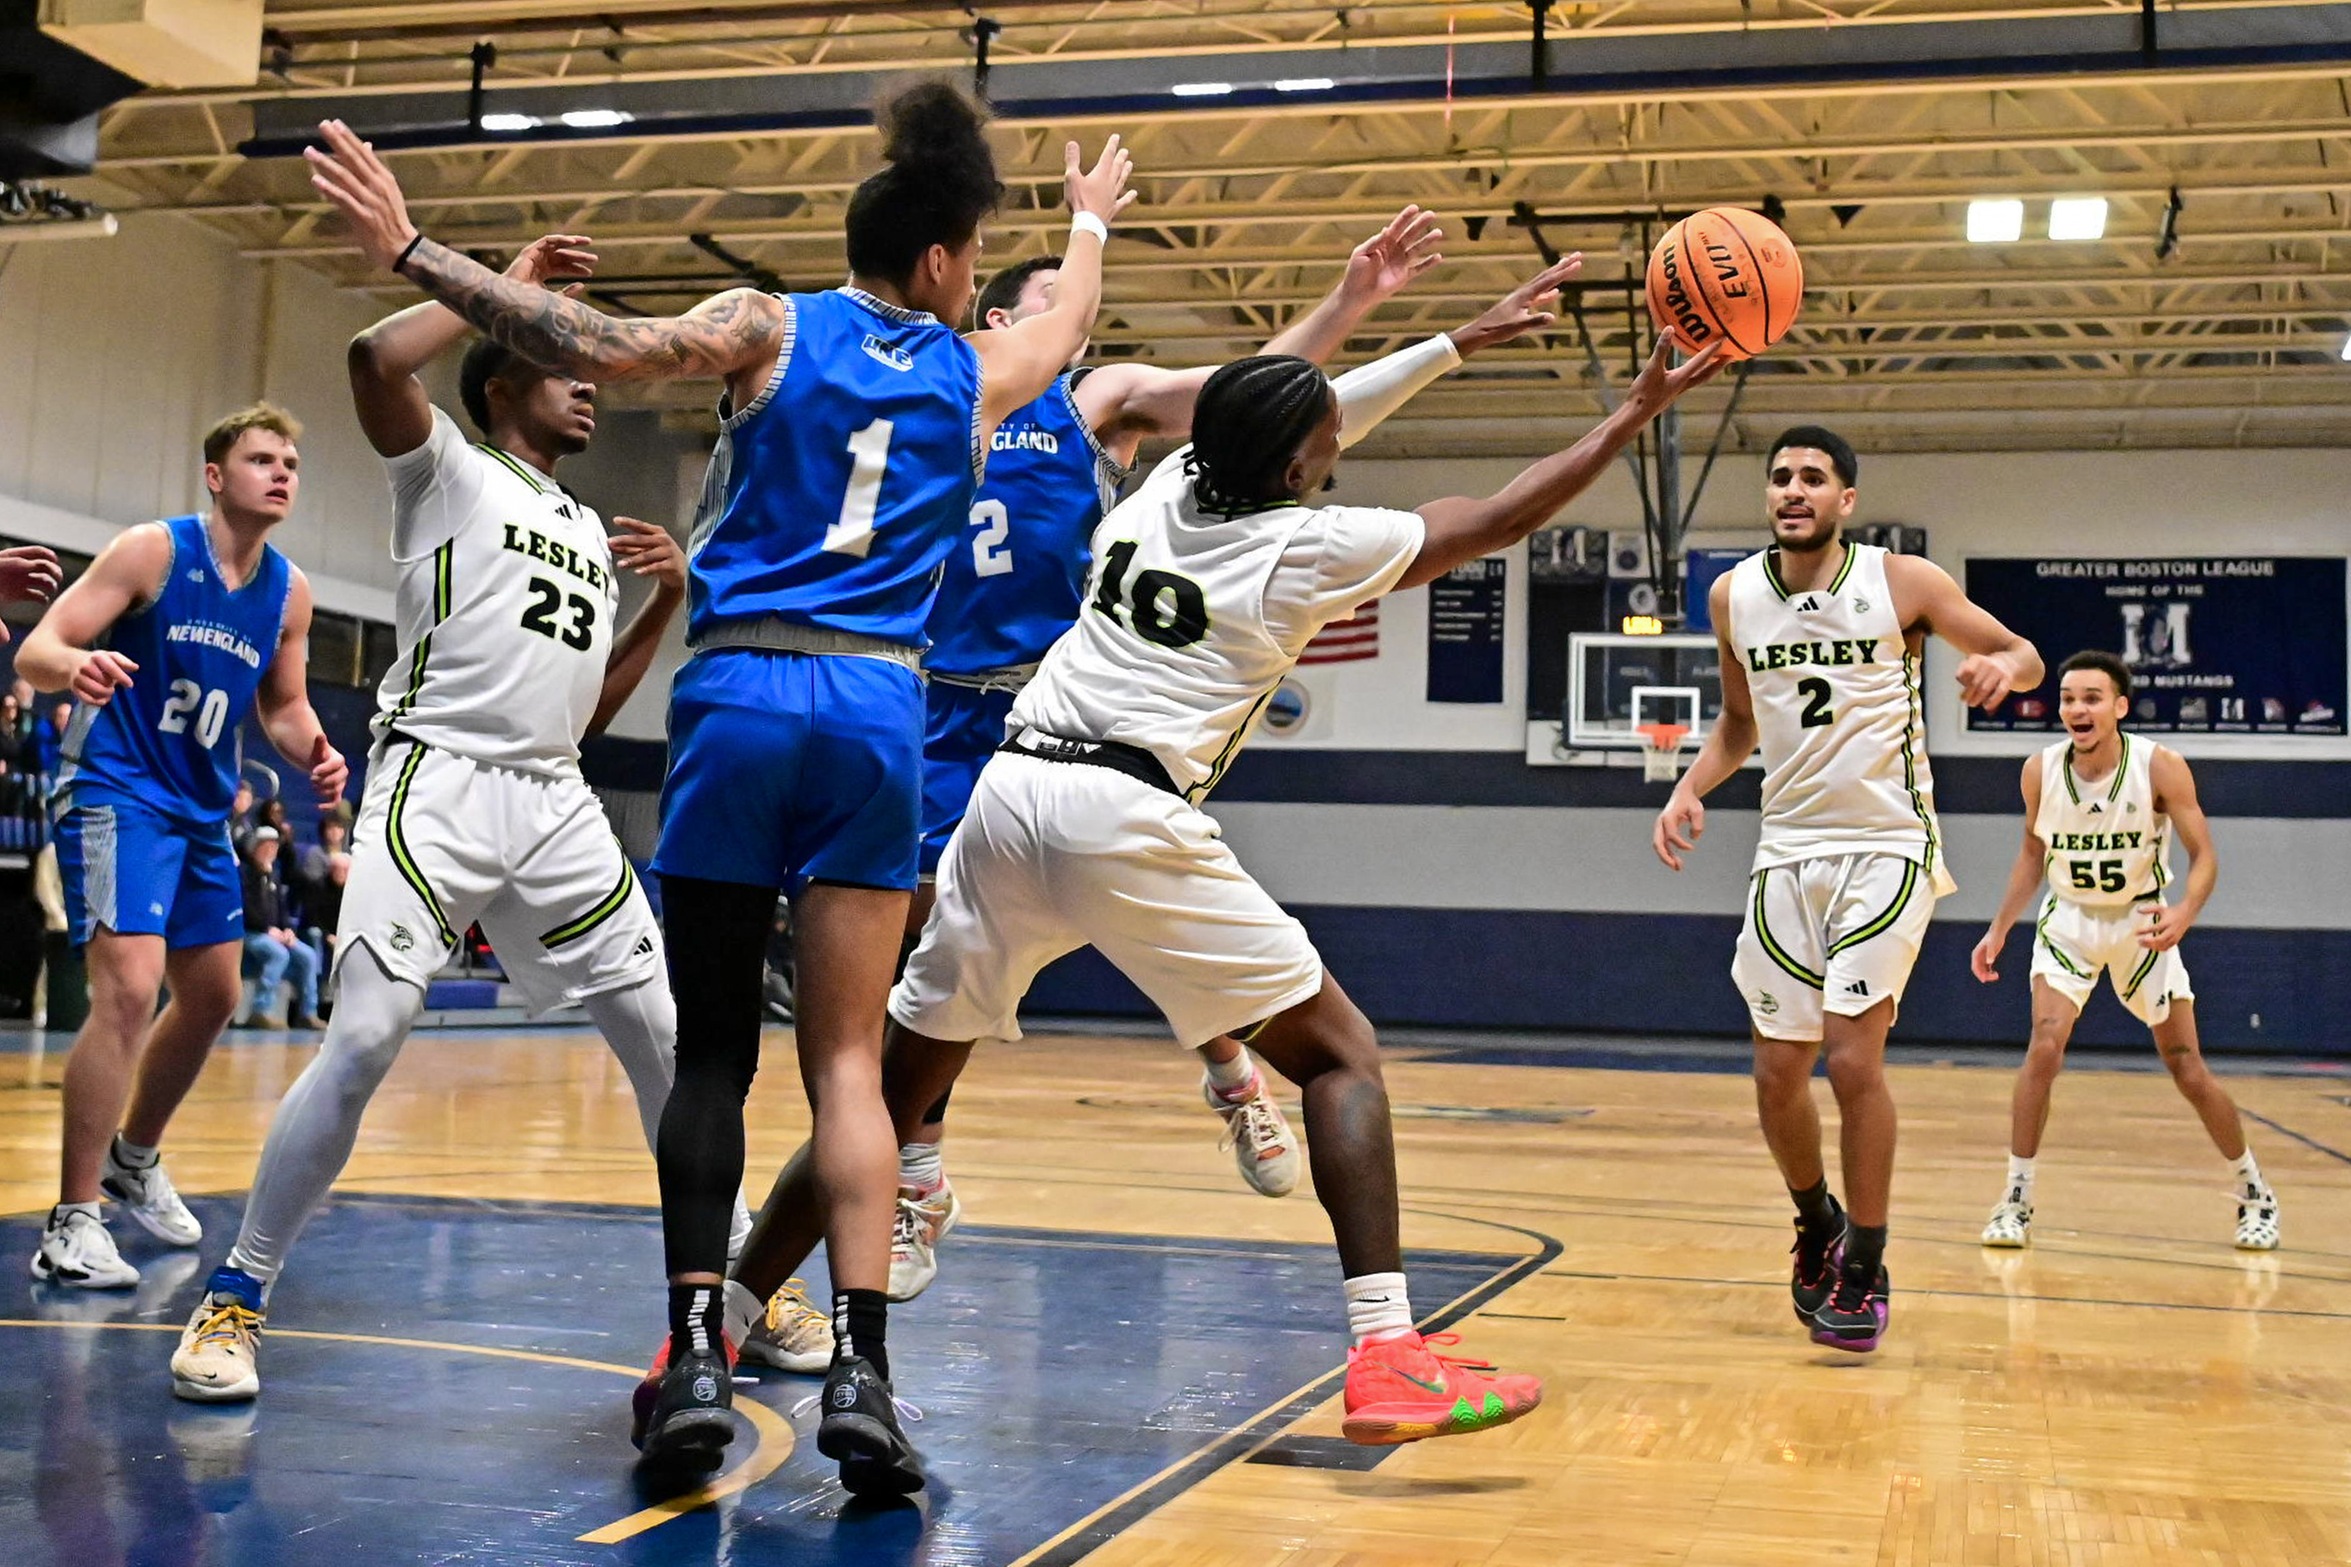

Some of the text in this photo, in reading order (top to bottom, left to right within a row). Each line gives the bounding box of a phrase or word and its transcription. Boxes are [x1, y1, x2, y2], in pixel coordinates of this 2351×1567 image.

[1663, 243, 1712, 344] Wilson
[990, 430, 1059, 455] GLAND
[820, 417, 895, 559] 1
[2036, 560, 2275, 577] GREATER BOSTON LEAGUE
[1091, 539, 1209, 648] 10
[2151, 585, 2171, 597] OF
[2177, 584, 2204, 596] THE
[520, 575, 597, 653] 23
[1747, 638, 1879, 674] LESLEY
[2154, 674, 2235, 687] MUSTANGS
[157, 677, 230, 750] 20
[1797, 676, 1834, 729] 2
[2051, 830, 2142, 851] LESLEY
[2069, 859, 2127, 893] 55
